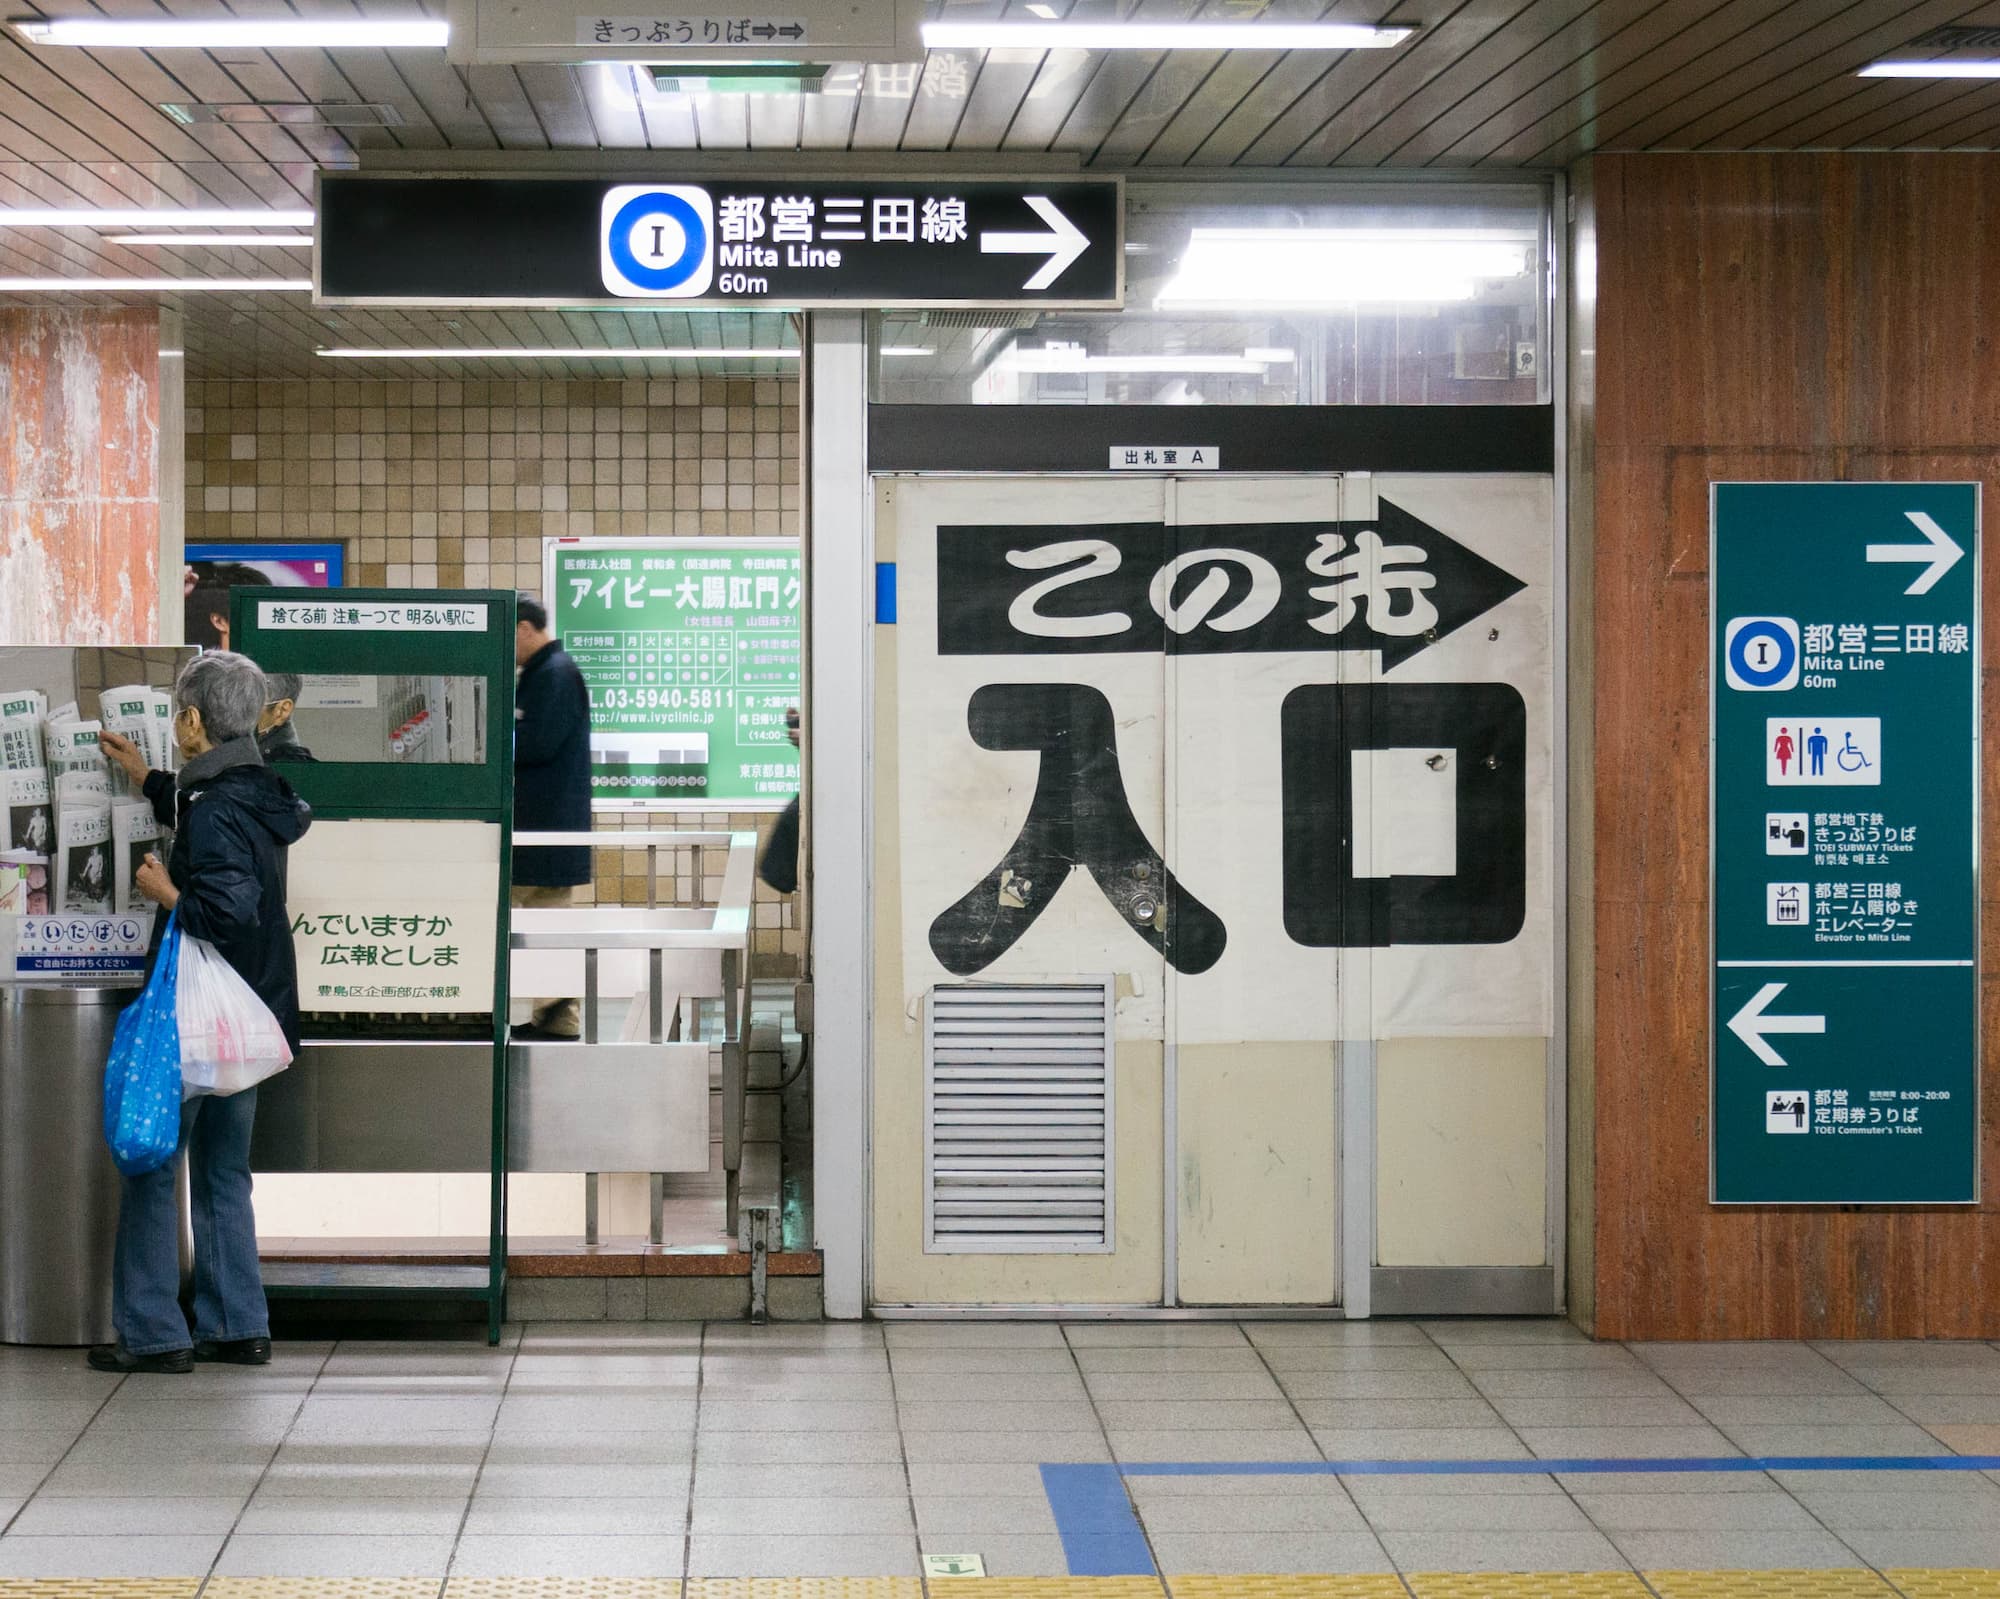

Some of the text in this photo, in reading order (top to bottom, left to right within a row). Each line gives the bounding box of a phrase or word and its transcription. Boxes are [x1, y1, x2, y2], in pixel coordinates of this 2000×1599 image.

[594, 19, 751, 43] きっぷうりば
[718, 196, 968, 243] 都営三田線
[650, 225, 665, 257] I
[719, 245, 842, 268] Mita Line
[718, 273, 768, 294] 60m
[1125, 449, 1204, 465] 出札室 A
[1004, 530, 1439, 637] この先
[271, 607, 475, 626] 捨てる前 注意一つで 明るい駅に
[572, 636, 615, 647] 受付時間
[628, 637, 637, 647] 月
[645, 636, 656, 647] 火
[718, 637, 728, 647] 土
[1803, 623, 1970, 654] 都営三田線
[1757, 643, 1768, 665] I
[1803, 656, 1885, 671] Mita Line
[1803, 675, 1837, 689] 60m
[1814, 813, 1884, 827] 都営地下鉄
[928, 682, 1527, 976] 入口
[1814, 826, 1917, 843] きっぷうりば
[1814, 843, 1914, 853] TOEI SUBWAY Tickets
[1814, 882, 1902, 899] 都営三田線
[1815, 900, 1919, 917] ホーム階ゆき
[44, 922, 137, 941] いたばし
[291, 912, 453, 937] んでいますか
[1815, 918, 1913, 933] エレベーター
[1814, 933, 1912, 943] Elevator to Mita Line
[34, 957, 130, 969] ご自由にお持ちください
[319, 943, 460, 967] 広報としま
[1814, 1089, 1849, 1106] 都営
[1814, 1107, 1920, 1124] 定期券うりば
[1814, 1126, 1923, 1135] TOEI Commuter's Ticket
